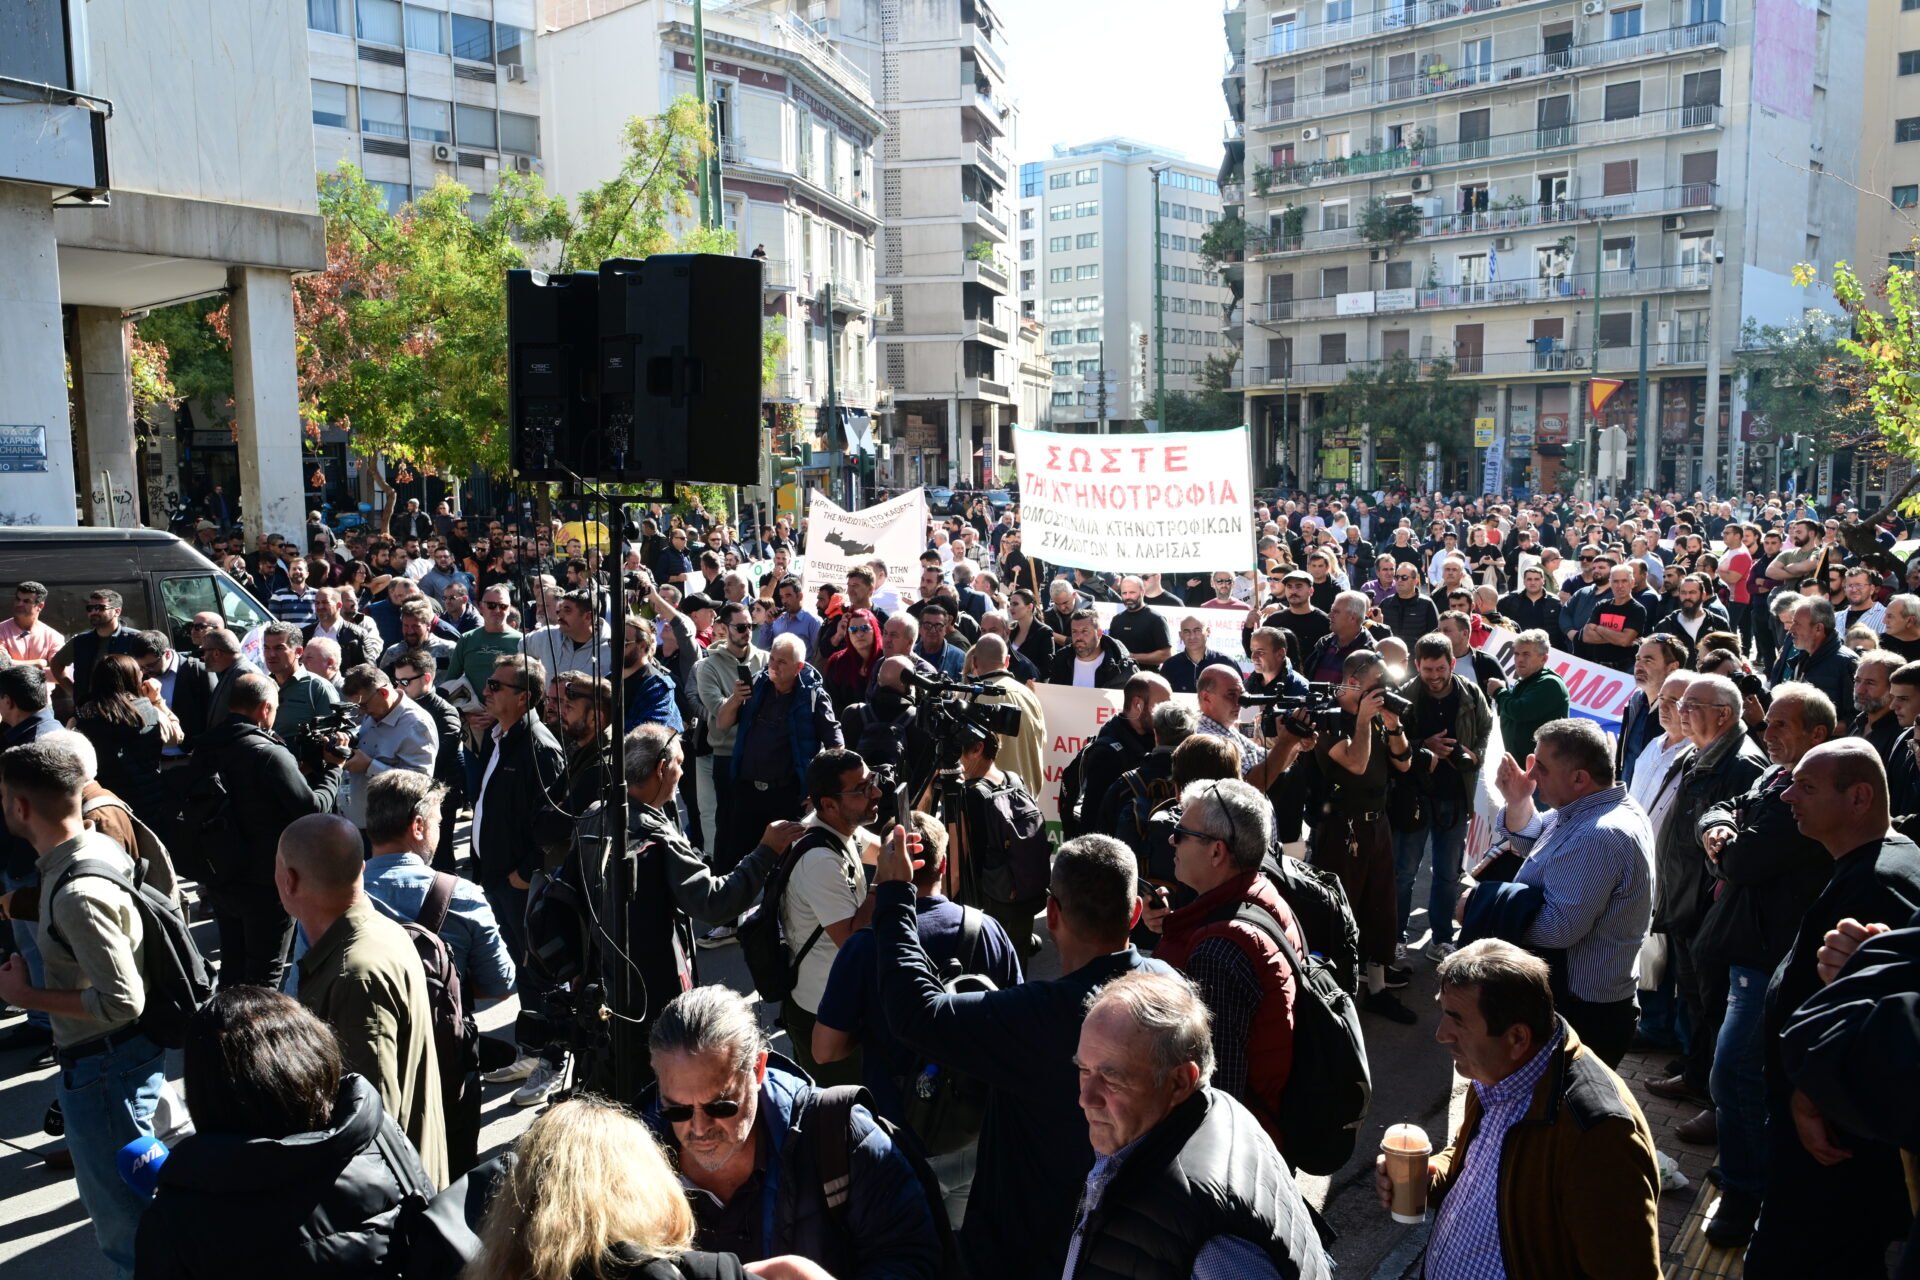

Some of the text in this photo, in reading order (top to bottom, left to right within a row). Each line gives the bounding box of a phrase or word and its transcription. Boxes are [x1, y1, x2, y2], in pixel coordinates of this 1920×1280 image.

[1511, 404, 1528, 412] TIME
[1046, 445, 1189, 473] ΣΩΣΤΕ
[1052, 479, 1238, 510] ΚΤΗΝΟΤΡΟΦΙΑ
[1106, 515, 1242, 537] ΚΤΗΝΟΤΡΟΦΙΚΩΝ
[1135, 541, 1201, 559] ΛΑΡΙΣΑΣ
